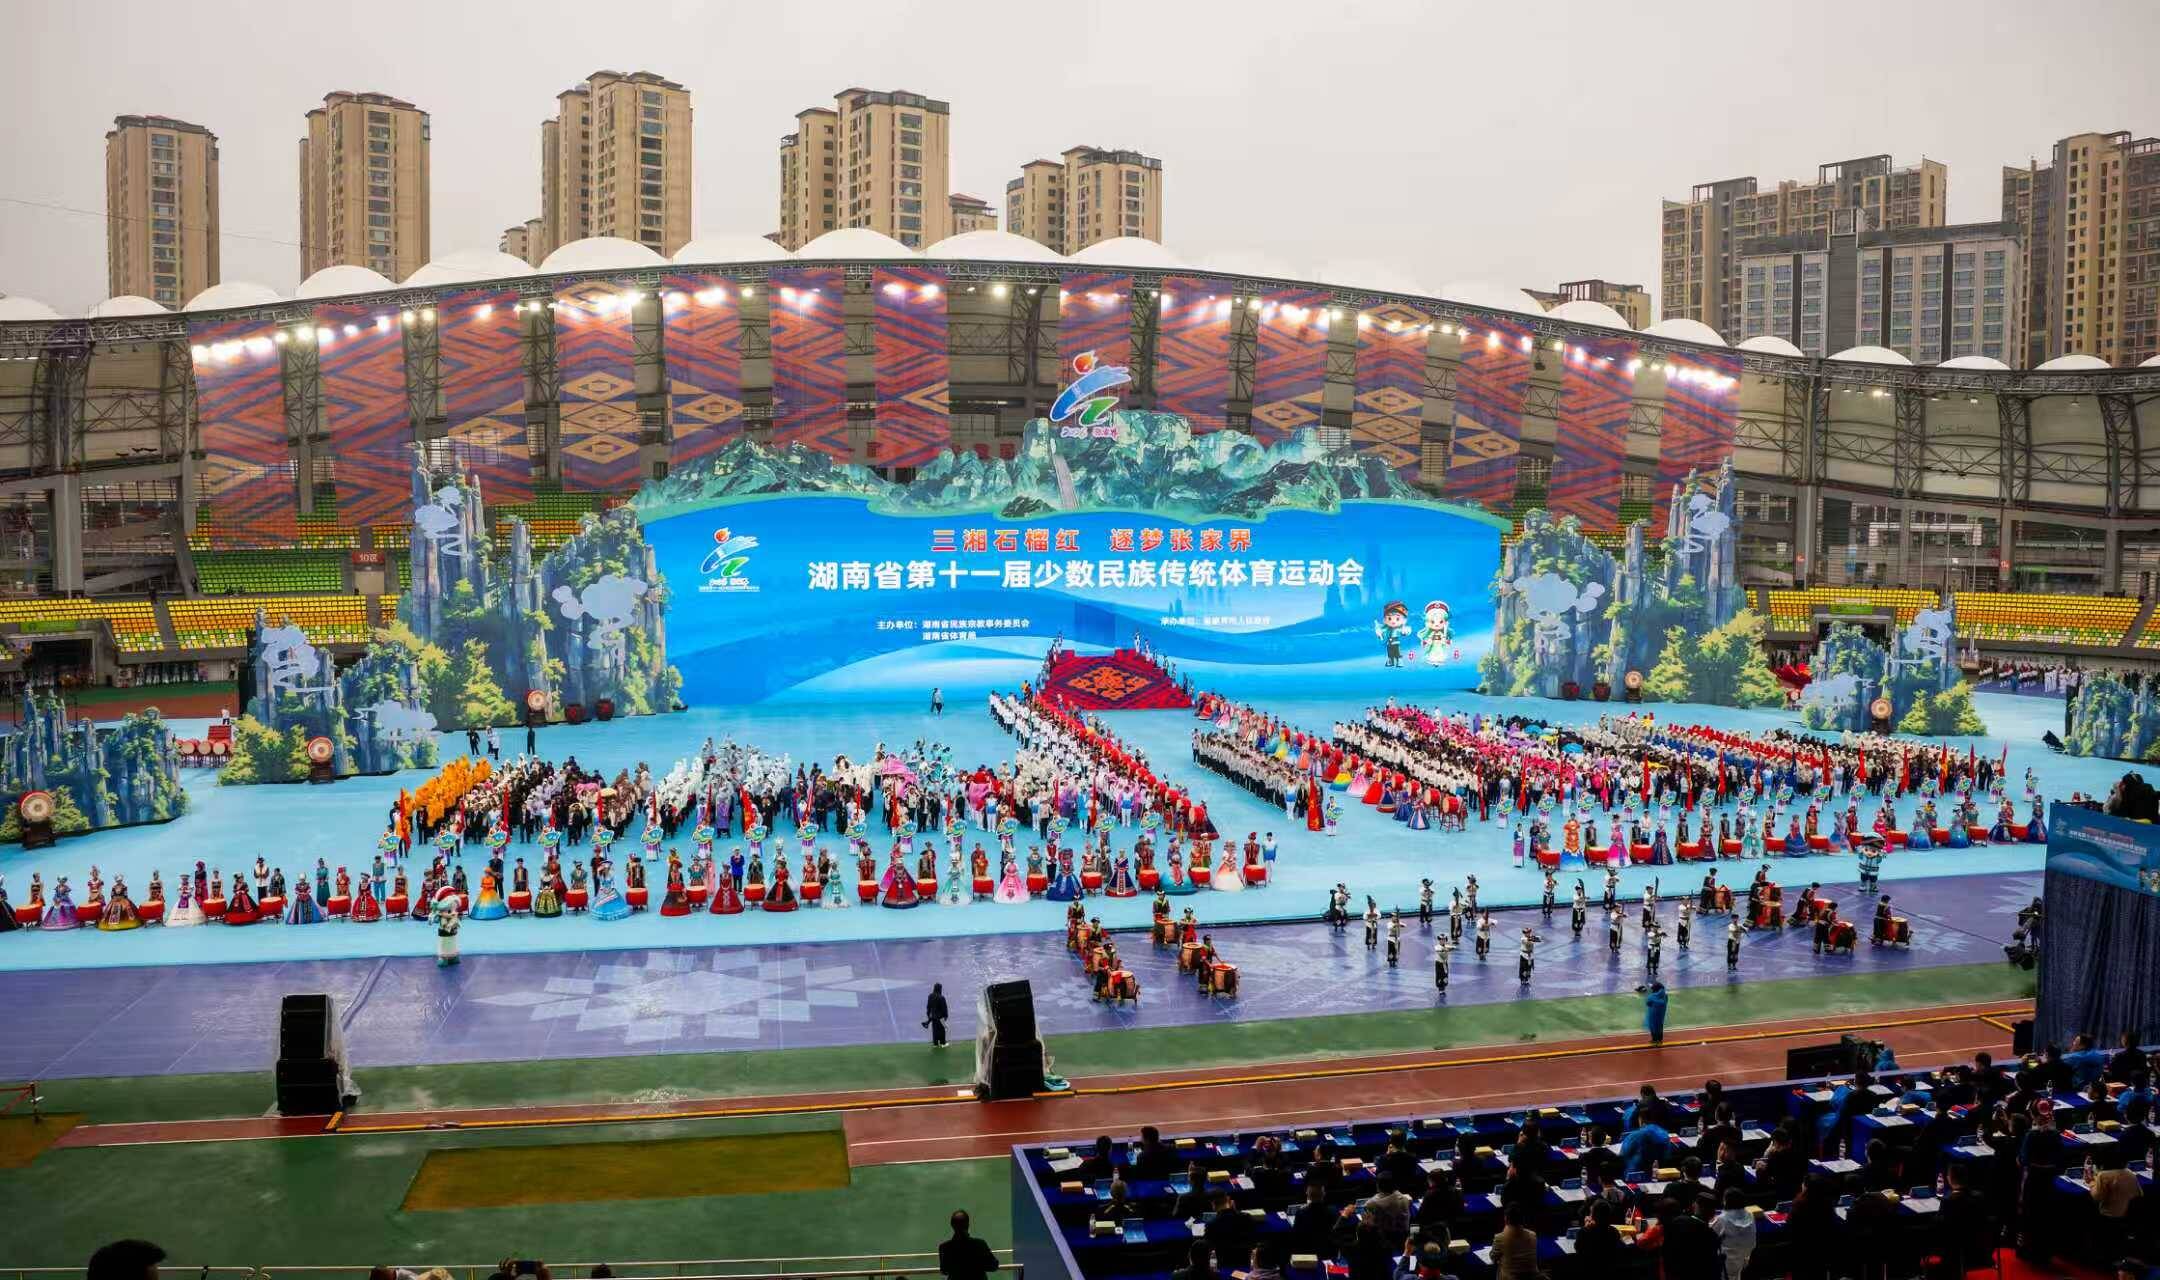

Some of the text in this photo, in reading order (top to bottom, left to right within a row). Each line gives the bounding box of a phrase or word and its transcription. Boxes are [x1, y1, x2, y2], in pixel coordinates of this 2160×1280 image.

[931, 528, 1252, 552] 三湘石榴红 逐梦张家界
[808, 558, 1364, 590] 湖南省第十一届少数民族传统体育运动会
